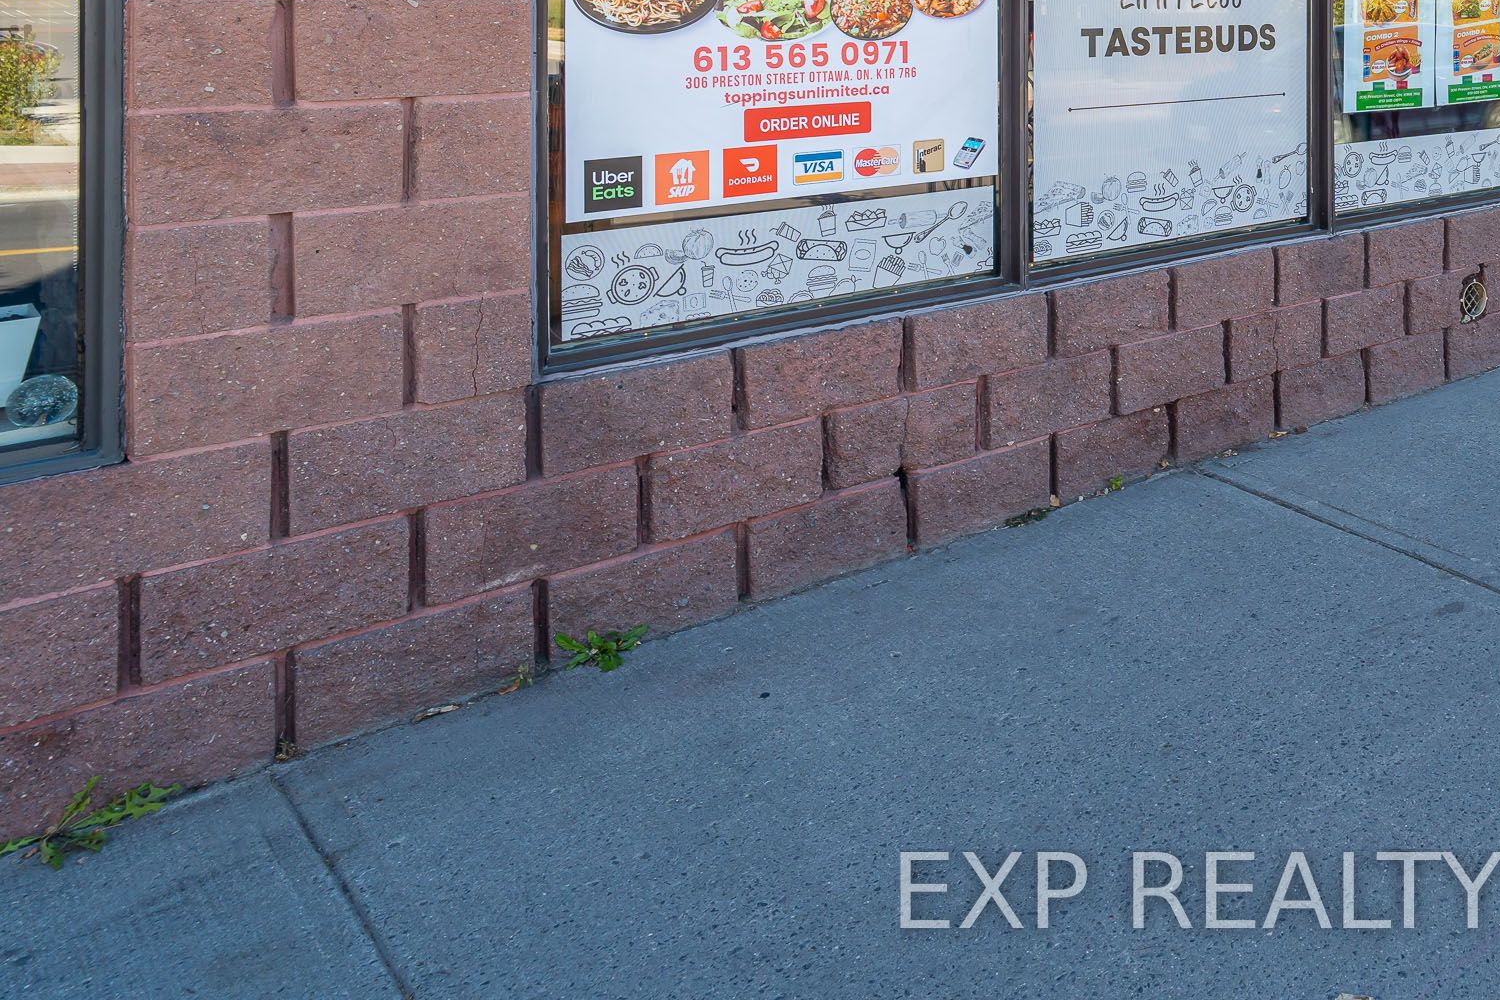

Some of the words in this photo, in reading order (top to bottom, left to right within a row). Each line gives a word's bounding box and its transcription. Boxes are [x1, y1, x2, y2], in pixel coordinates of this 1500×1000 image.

[1080, 23, 1276, 58] TASTEBUDS
[693, 45, 751, 73] 613
[765, 43, 829, 69] 565
[841, 41, 909, 66] 0971
[685, 76, 708, 90] 306
[712, 73, 762, 88] PRESTON
[766, 71, 805, 85] STREET
[809, 69, 853, 83] OTTAWA.
[856, 69, 873, 81] ON.
[876, 68, 895, 80] K1R
[899, 66, 917, 79] 7R6
[724, 84, 890, 107] toppingsunlimited.ca
[760, 116, 808, 133] ORDER
[811, 112, 860, 129] ONLINE
[803, 160, 835, 174] VISA
[855, 154, 899, 169] MasterCard
[592, 170, 634, 186] Uber
[728, 174, 773, 186] DOORDASH
[592, 184, 635, 201] Eats
[667, 185, 695, 199] SKIP
